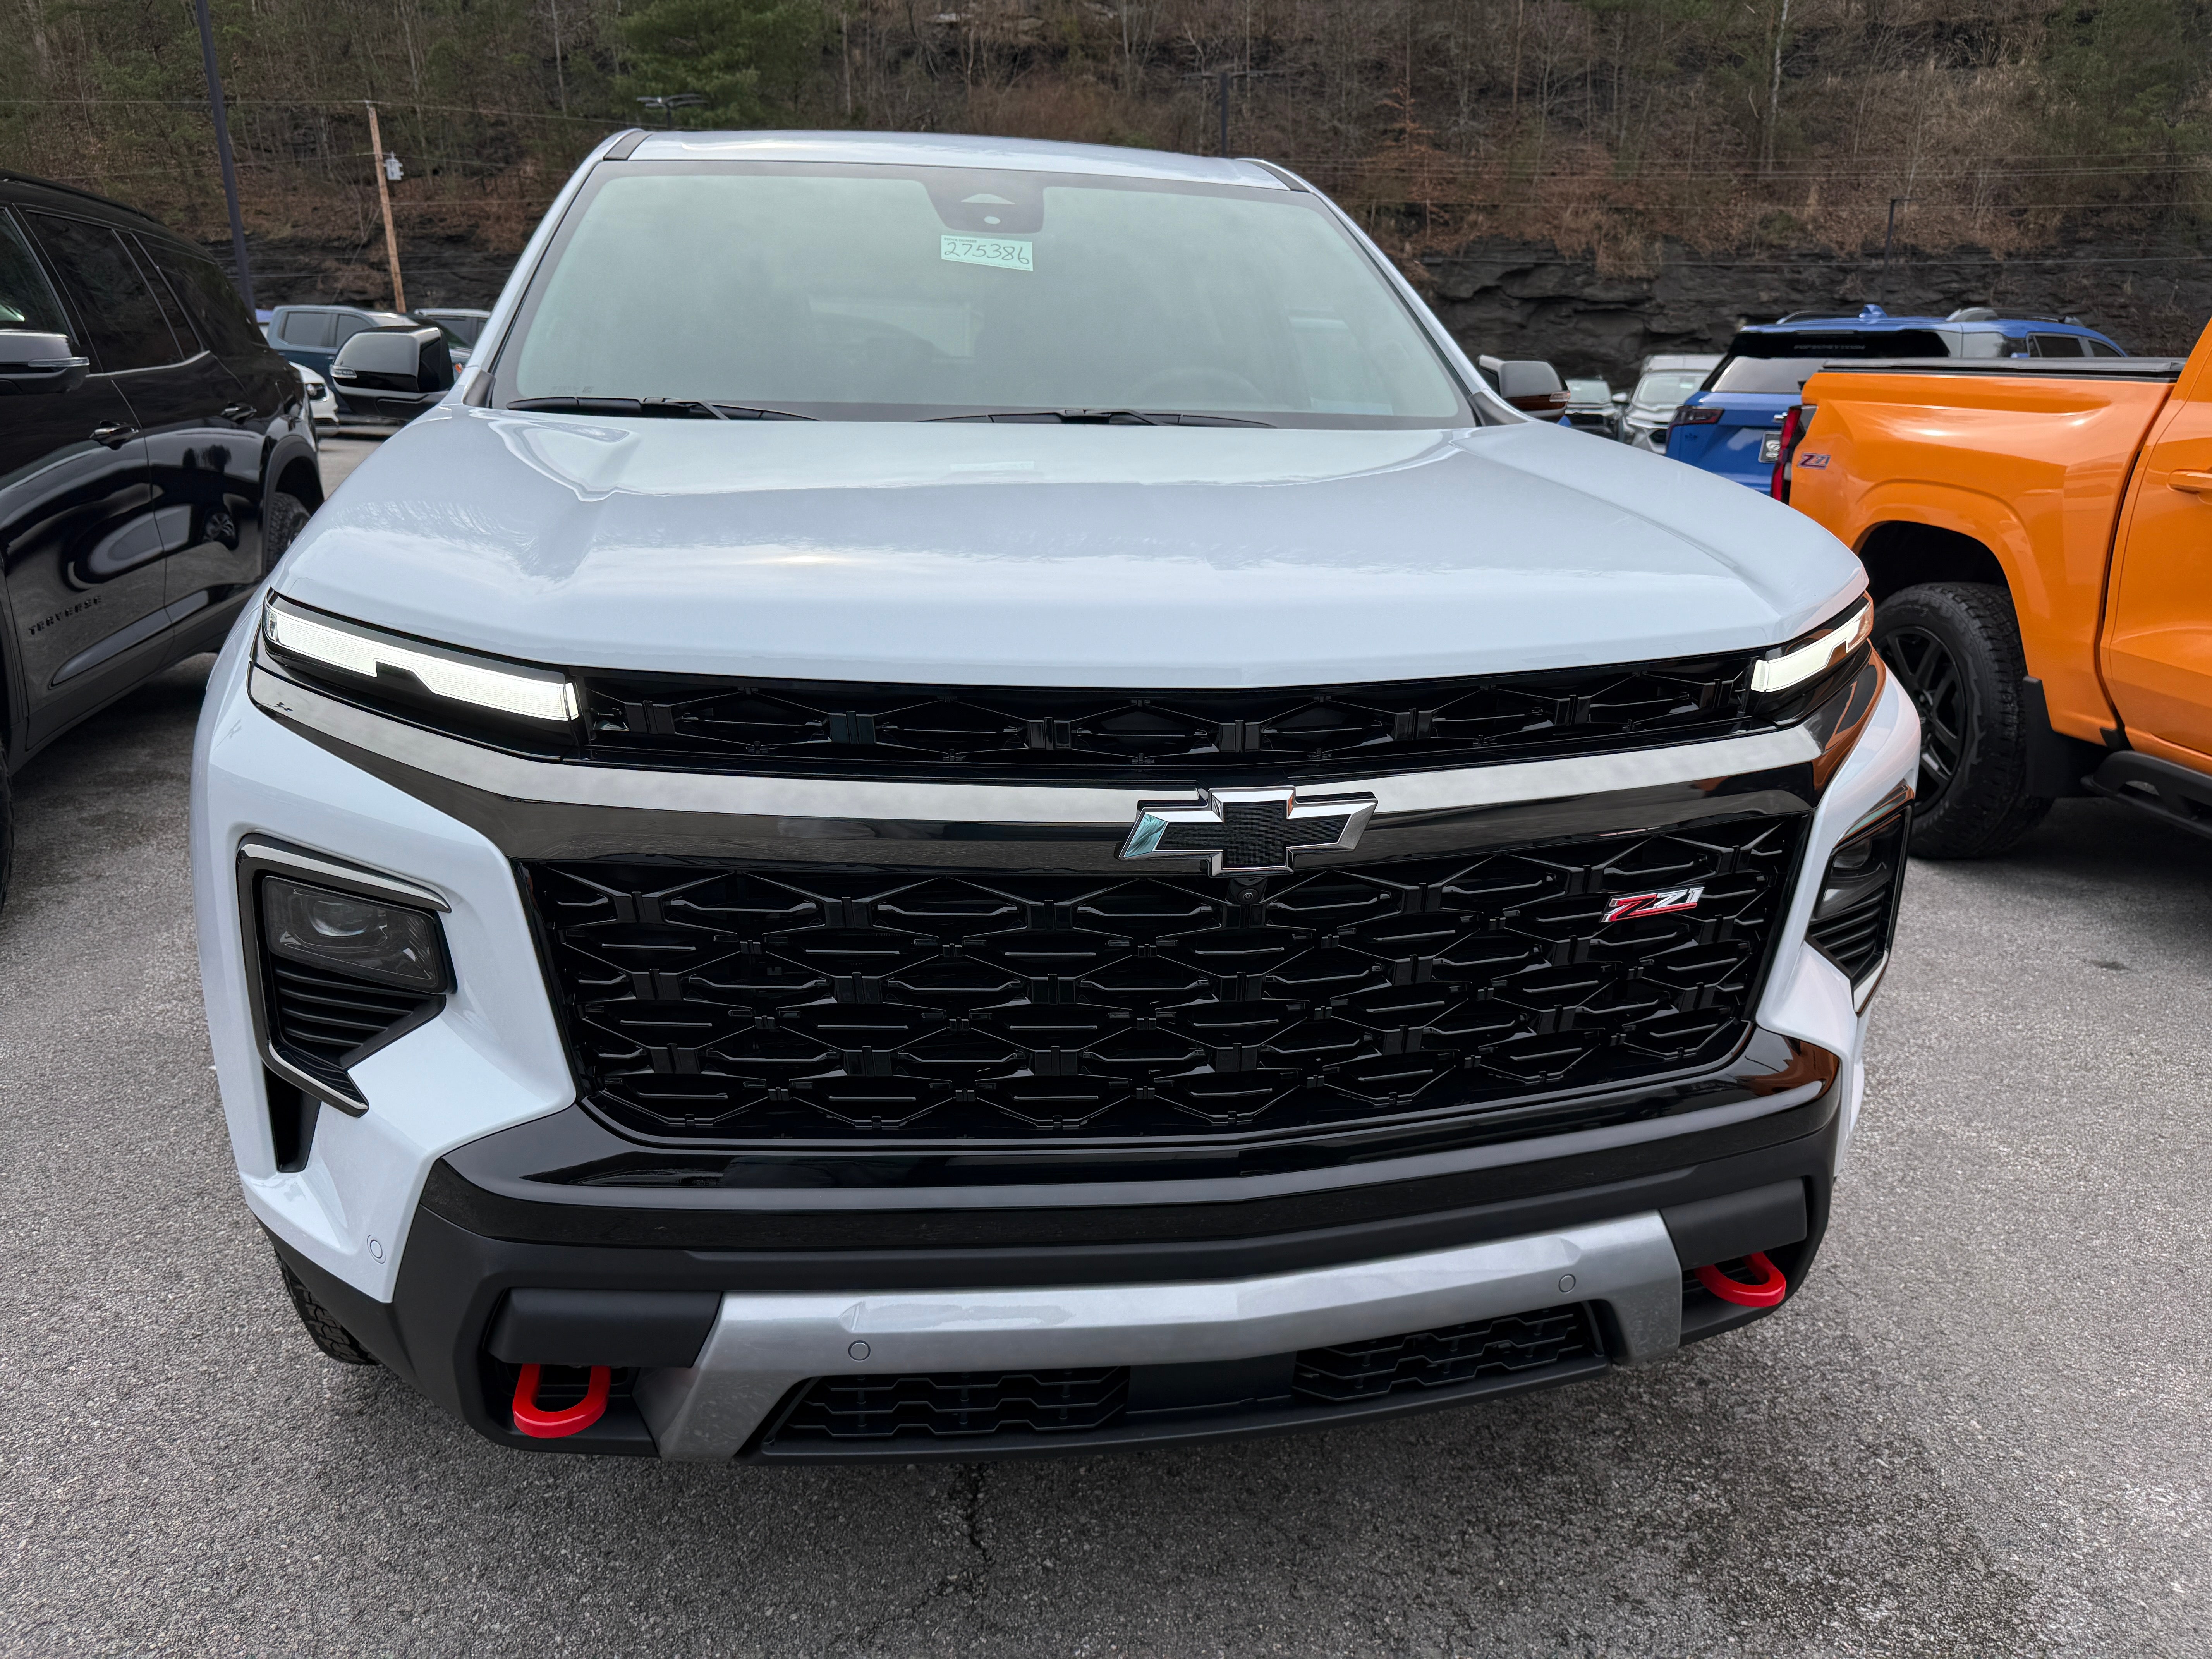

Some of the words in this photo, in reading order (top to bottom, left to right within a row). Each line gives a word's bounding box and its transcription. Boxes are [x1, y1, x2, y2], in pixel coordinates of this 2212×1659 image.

[944, 242, 1030, 264] 275386
[1797, 452, 1832, 470] Z71
[28, 595, 101, 635] TRAVERSE
[1601, 886, 1705, 922] Z71
